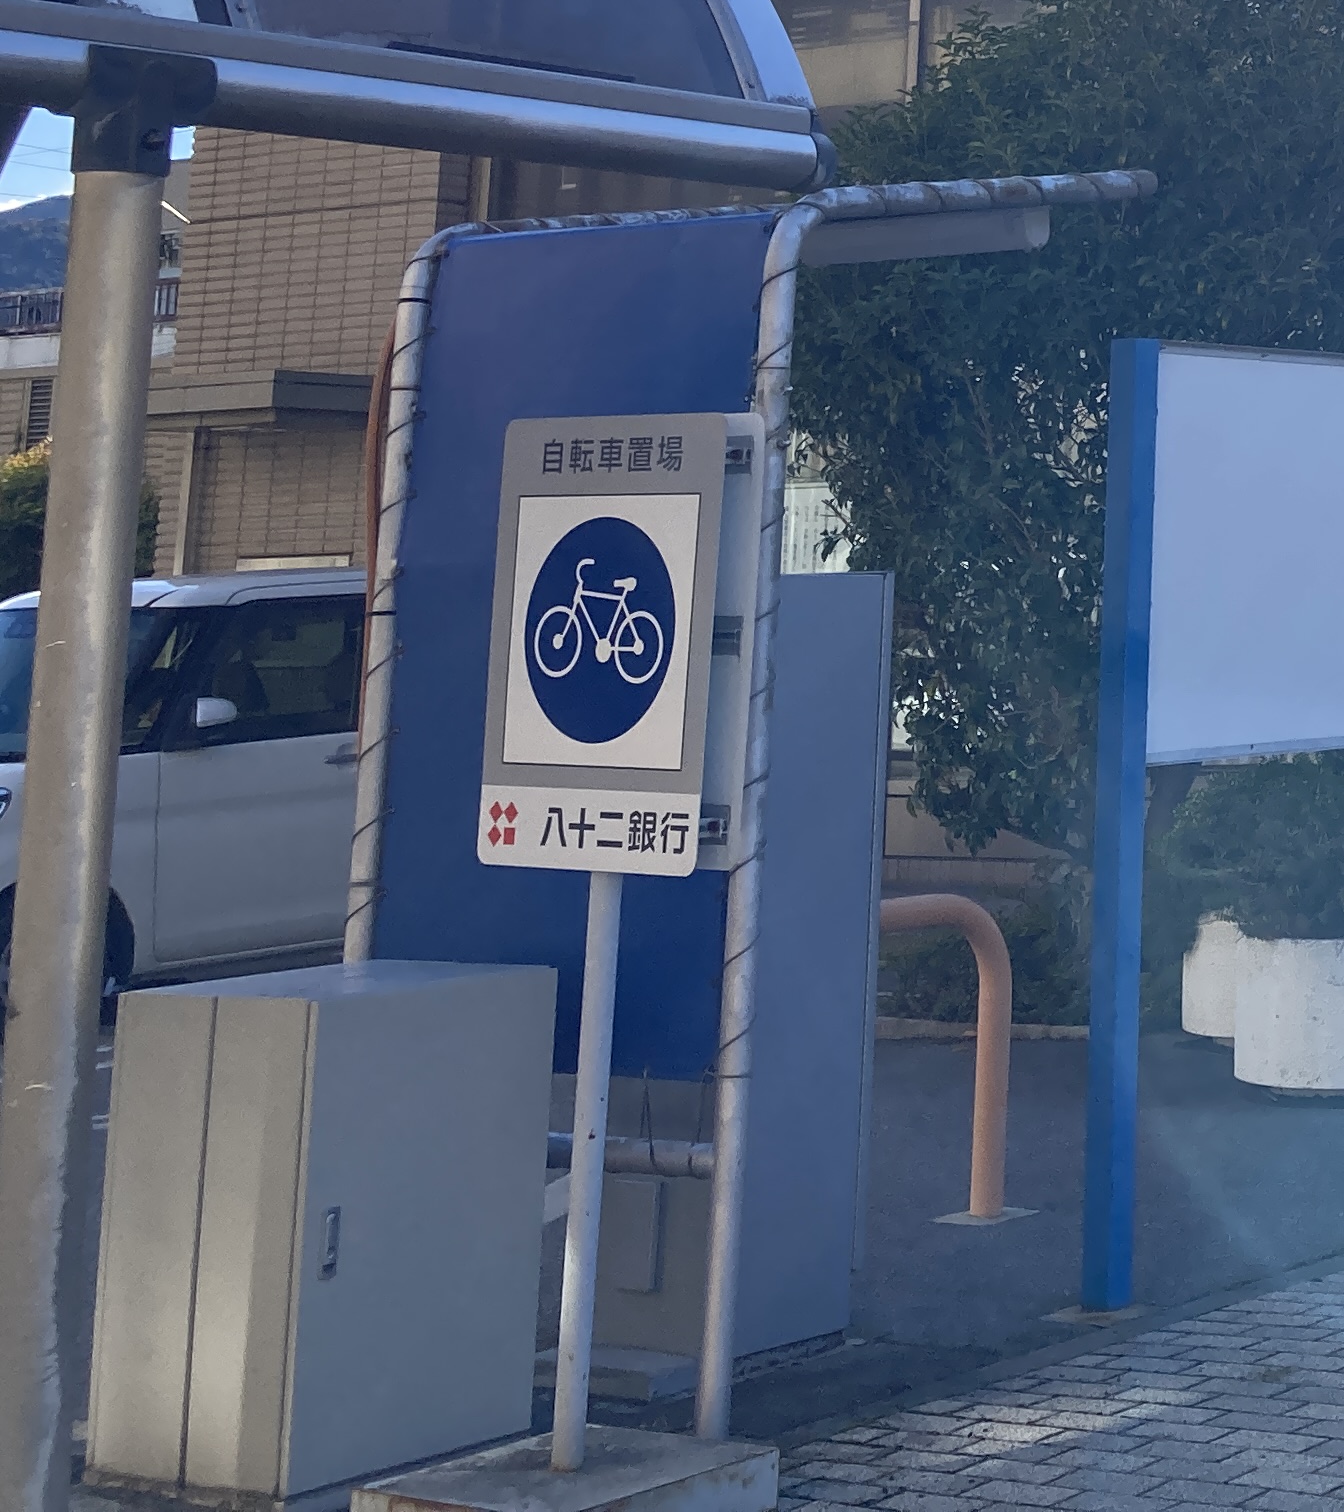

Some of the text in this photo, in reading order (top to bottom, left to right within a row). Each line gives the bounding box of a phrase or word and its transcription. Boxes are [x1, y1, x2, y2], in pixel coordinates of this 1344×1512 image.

[542, 435, 685, 474] 自転車置場
[540, 807, 690, 854] 八十二銀行
